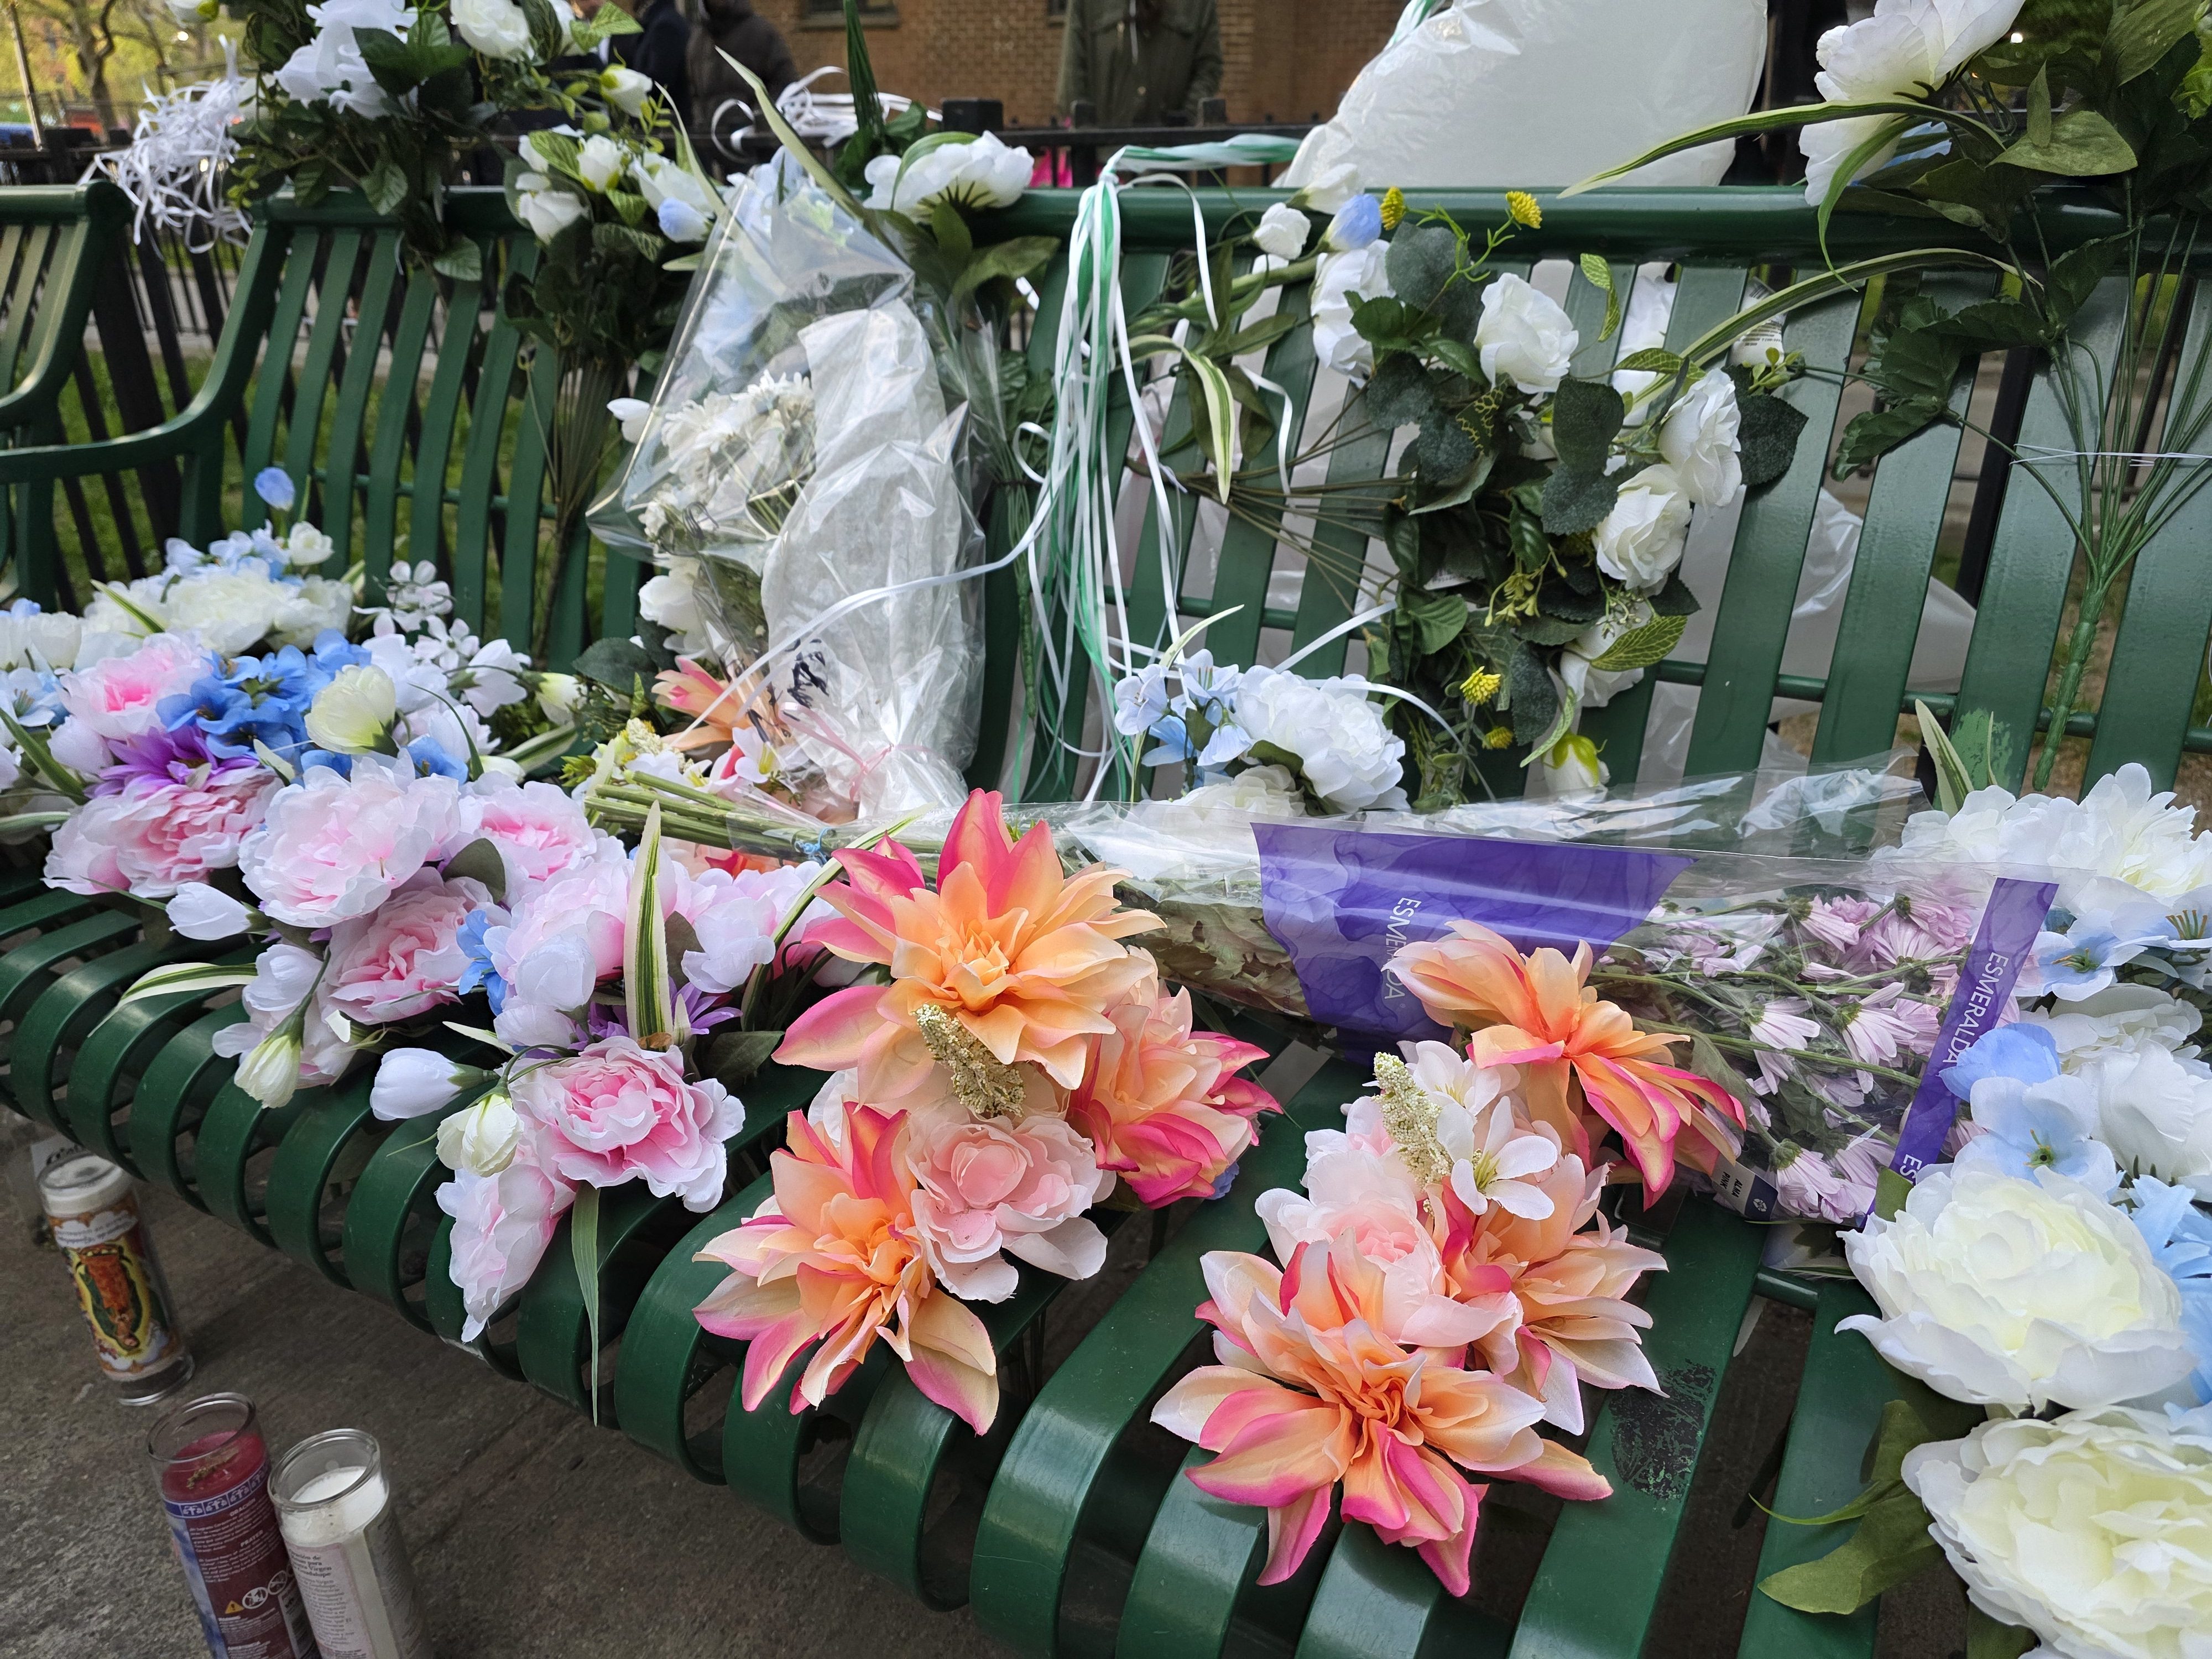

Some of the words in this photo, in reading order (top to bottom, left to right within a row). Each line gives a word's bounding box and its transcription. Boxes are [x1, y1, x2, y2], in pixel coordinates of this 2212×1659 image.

[1384, 897, 1422, 999] ESMEDA
[1942, 952, 2009, 1063] ESMERALDA
[1900, 1154, 1923, 1179] ES
[1720, 1171, 1730, 1190] PINK
[1731, 1178, 1743, 1198] ALMA
